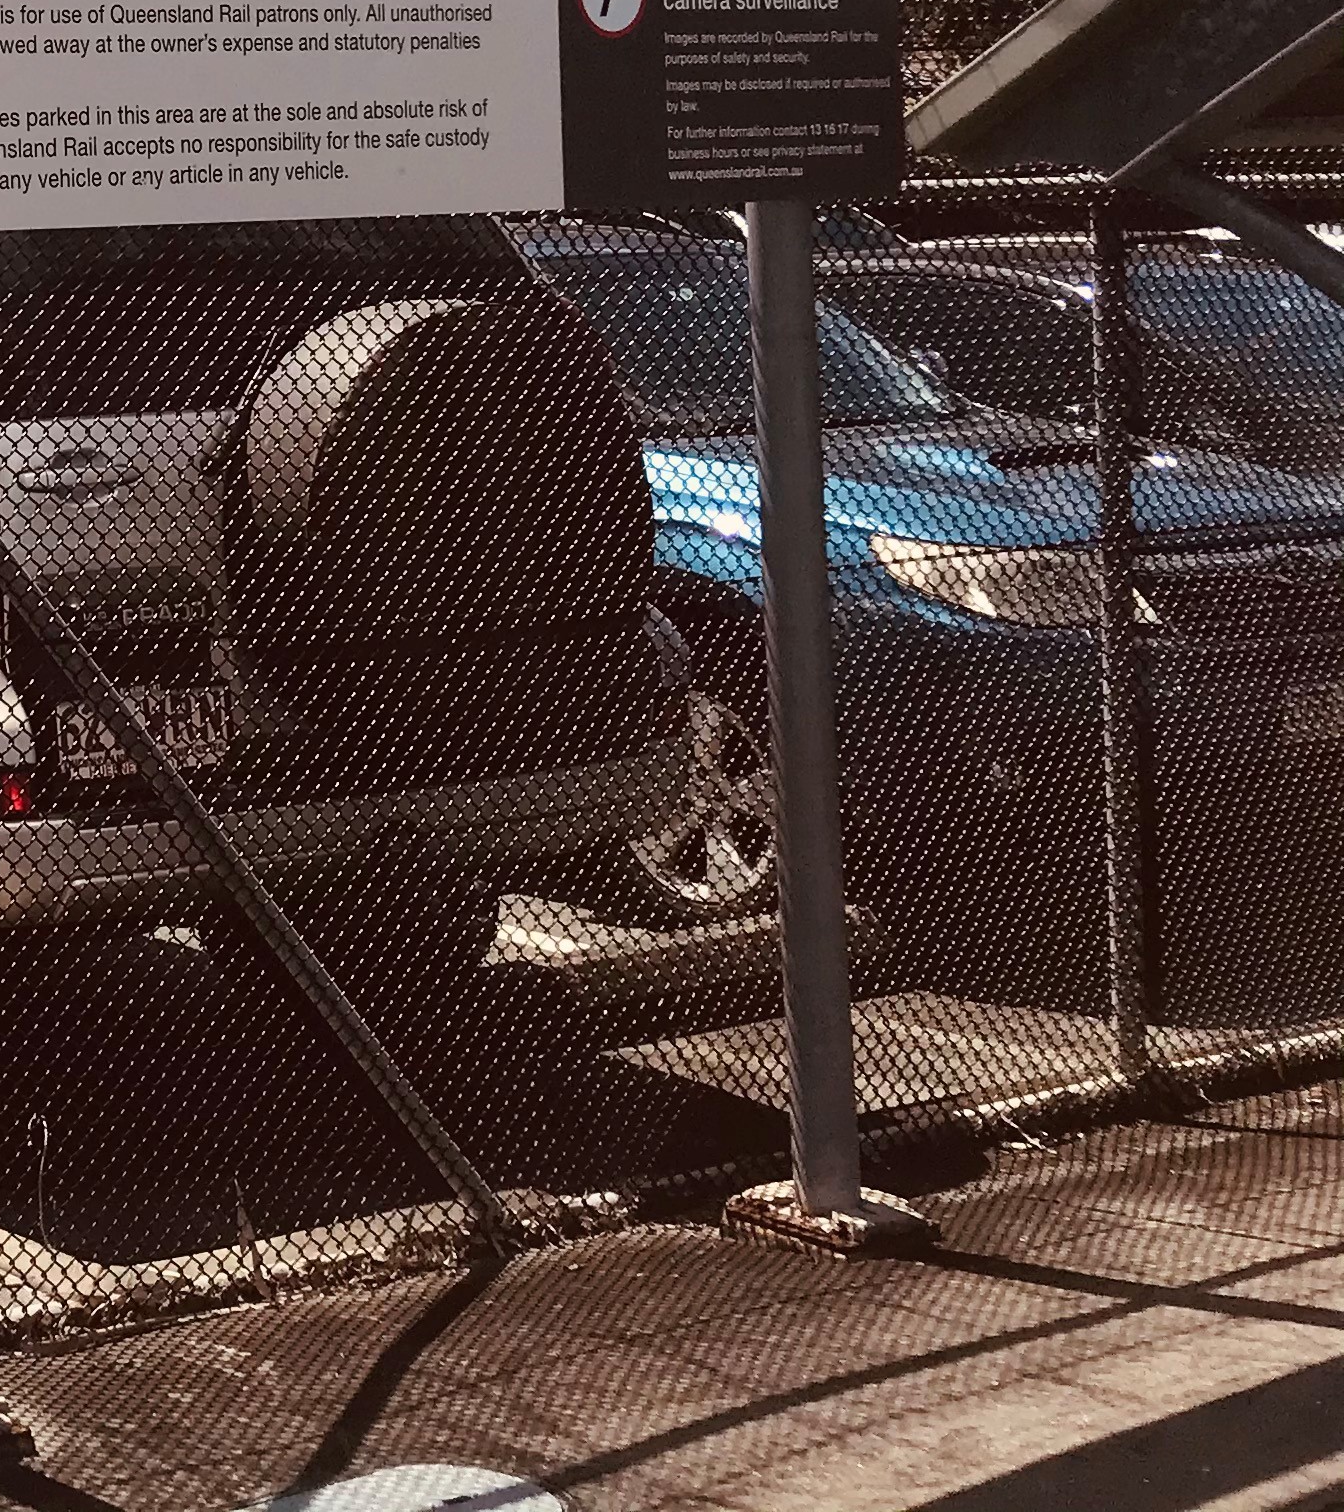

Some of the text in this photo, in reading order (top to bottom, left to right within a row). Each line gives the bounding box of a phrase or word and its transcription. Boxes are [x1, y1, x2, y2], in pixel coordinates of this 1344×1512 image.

[0, 4, 15, 25] is
[19, 4, 45, 25] for
[50, 9, 82, 24] use
[87, 4, 105, 24] of
[110, 4, 214, 24] Queensland
[219, 3, 250, 23] Rail
[256, 4, 319, 27] patrons
[323, 3, 361, 27] only.
[365, 3, 386, 22] All
[390, 3, 492, 22] unauthorised
[43, 38, 90, 59] away
[95, 35, 113, 54] at
[117, 33, 146, 53] the
[222, 37, 294, 56] expense
[298, 32, 329, 52] and
[334, 33, 406, 55] statutory
[410, 31, 481, 54] penalties
[664, 31, 698, 46] Images
[700, 34, 715, 43] are
[717, 31, 758, 43] recorded
[761, 32, 771, 45] by
[849, 30, 862, 41] for
[664, 51, 809, 67] purposes of safety and security.
[666, 79, 700, 93] Images
[701, 81, 722, 92] may
[724, 78, 736, 90] be
[792, 78, 829, 91] required
[831, 79, 841, 88] or
[26, 105, 90, 132] parked
[96, 105, 112, 126] in
[117, 104, 150, 125] this
[155, 108, 194, 124] area
[199, 107, 227, 123] are
[232, 103, 249, 123] at
[253, 102, 282, 122] the
[286, 101, 322, 122] sole
[326, 100, 358, 121] and
[363, 99, 434, 120] absolute
[439, 98, 467, 118] risk
[471, 97, 488, 117] of
[666, 99, 698, 114] by law.
[667, 125, 683, 138] For
[685, 126, 717, 138] further
[718, 125, 770, 137] information
[772, 125, 807, 136] contact
[809, 123, 821, 135] 13
[824, 123, 835, 134] 16
[837, 122, 849, 133] 17
[64, 136, 97, 157] Rail
[103, 136, 175, 160] accepts
[180, 138, 203, 154] no
[208, 131, 322, 157] responsibility
[326, 130, 350, 150] for
[353, 130, 381, 149] the
[385, 128, 420, 149] safe
[425, 127, 489, 151] custody
[667, 143, 863, 159] business hours or see privacy statement at
[37, 167, 102, 189] vehicle
[108, 171, 127, 187] or
[131, 170, 164, 190] any
[169, 163, 223, 185] article
[228, 163, 243, 183] in
[248, 166, 280, 186] any
[284, 160, 349, 181] vehicle.
[668, 164, 803, 181] www.queenslandrail.com.au
